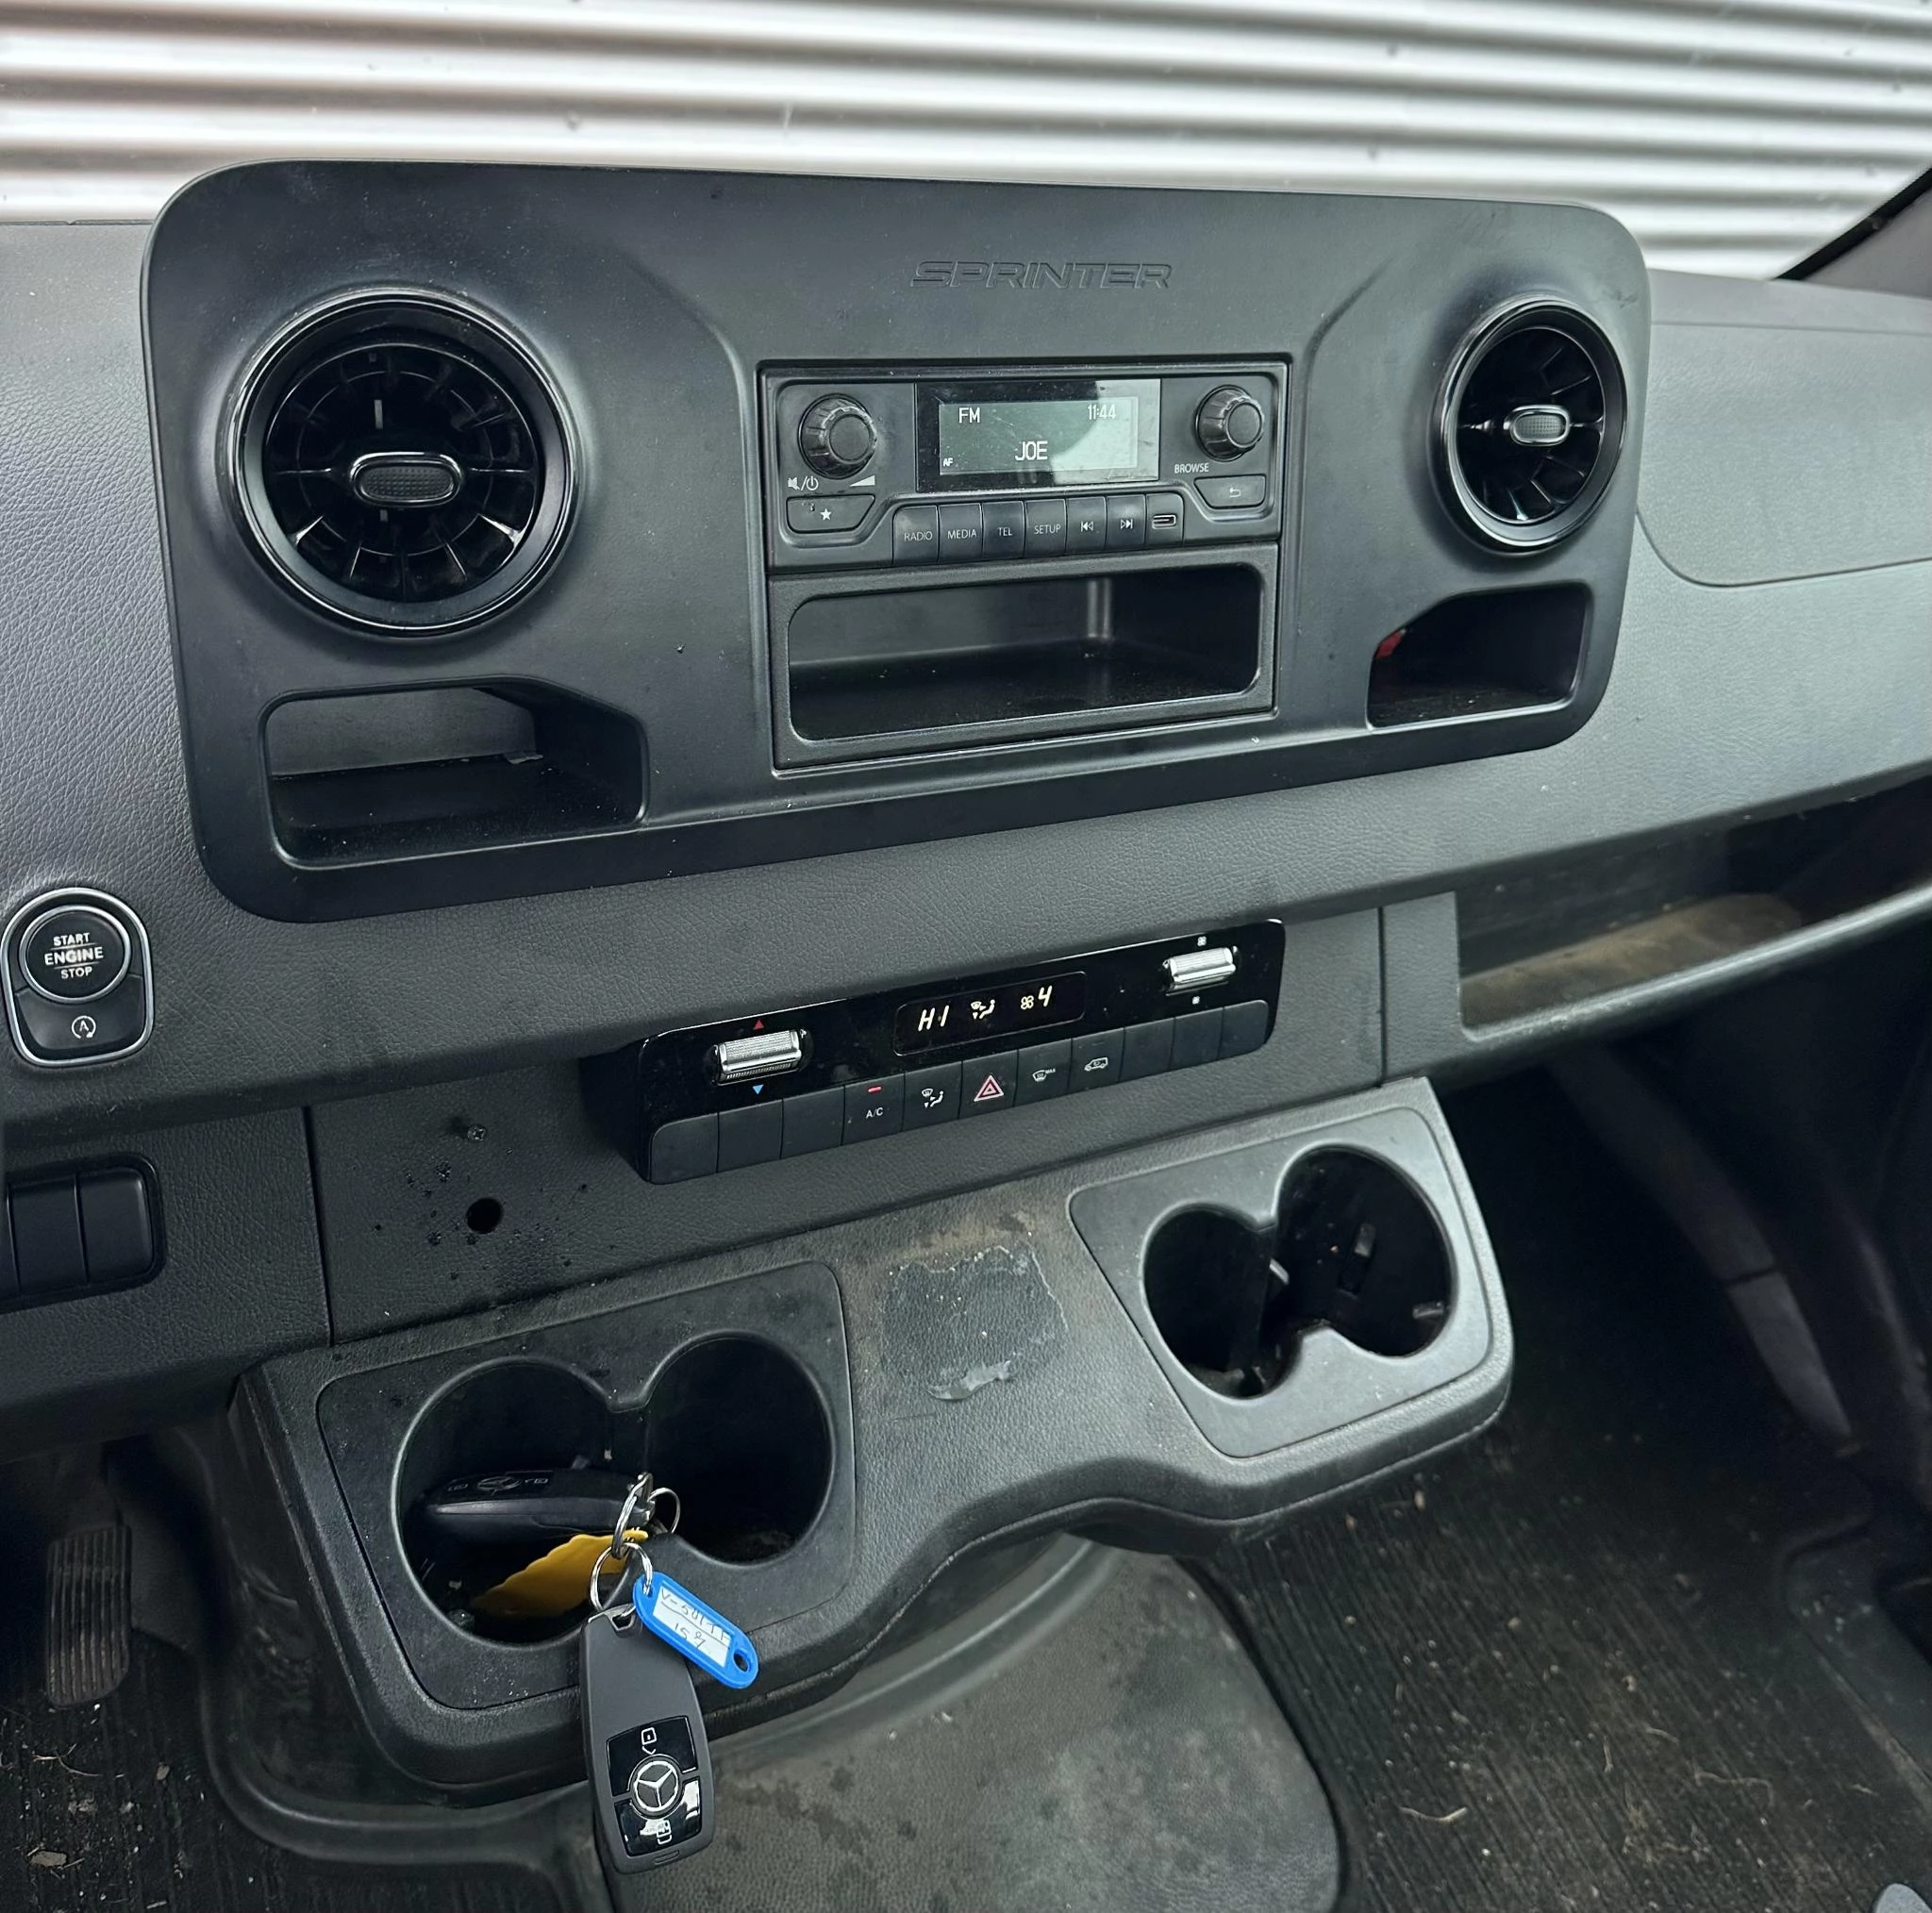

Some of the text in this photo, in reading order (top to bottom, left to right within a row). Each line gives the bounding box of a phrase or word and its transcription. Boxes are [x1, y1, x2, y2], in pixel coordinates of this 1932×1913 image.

[910, 260, 1174, 289] SPRINTER
[958, 407, 981, 424] FM
[1087, 404, 1117, 421] 11:44
[1014, 441, 1048, 461] JOE
[1174, 462, 1209, 474] BROWSE
[904, 530, 933, 541] RADIO
[947, 528, 977, 541] MEDIA
[997, 527, 1013, 537] TEL
[1034, 524, 1062, 535] SETUP
[53, 932, 91, 947] START
[43, 946, 105, 966] ENGINE
[60, 966, 93, 979] STOP
[1038, 985, 1053, 1007] 4
[917, 1005, 950, 1032] HI
[865, 1106, 884, 1119] A/C
